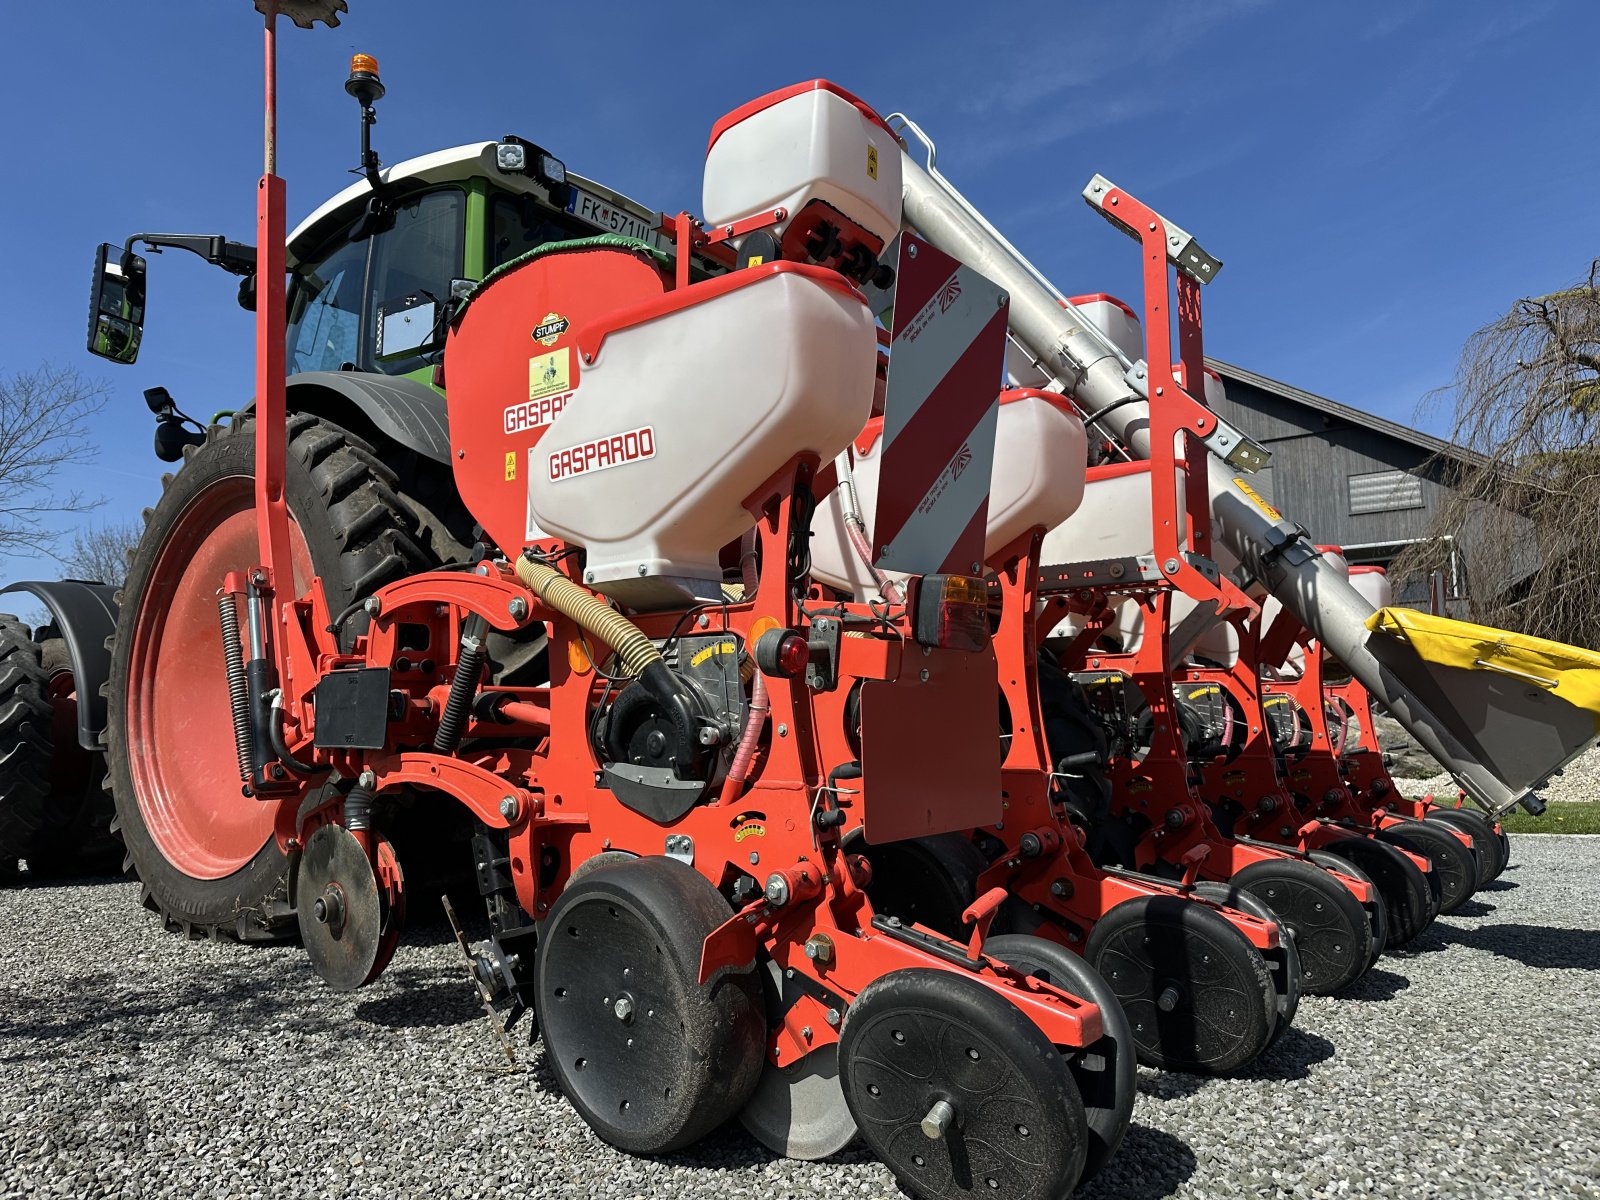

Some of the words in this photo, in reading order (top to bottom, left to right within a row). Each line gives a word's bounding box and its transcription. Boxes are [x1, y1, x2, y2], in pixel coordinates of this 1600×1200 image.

[581, 197, 601, 222] FK
[535, 321, 565, 338] STUMPF
[550, 427, 654, 480] GASPARDO
